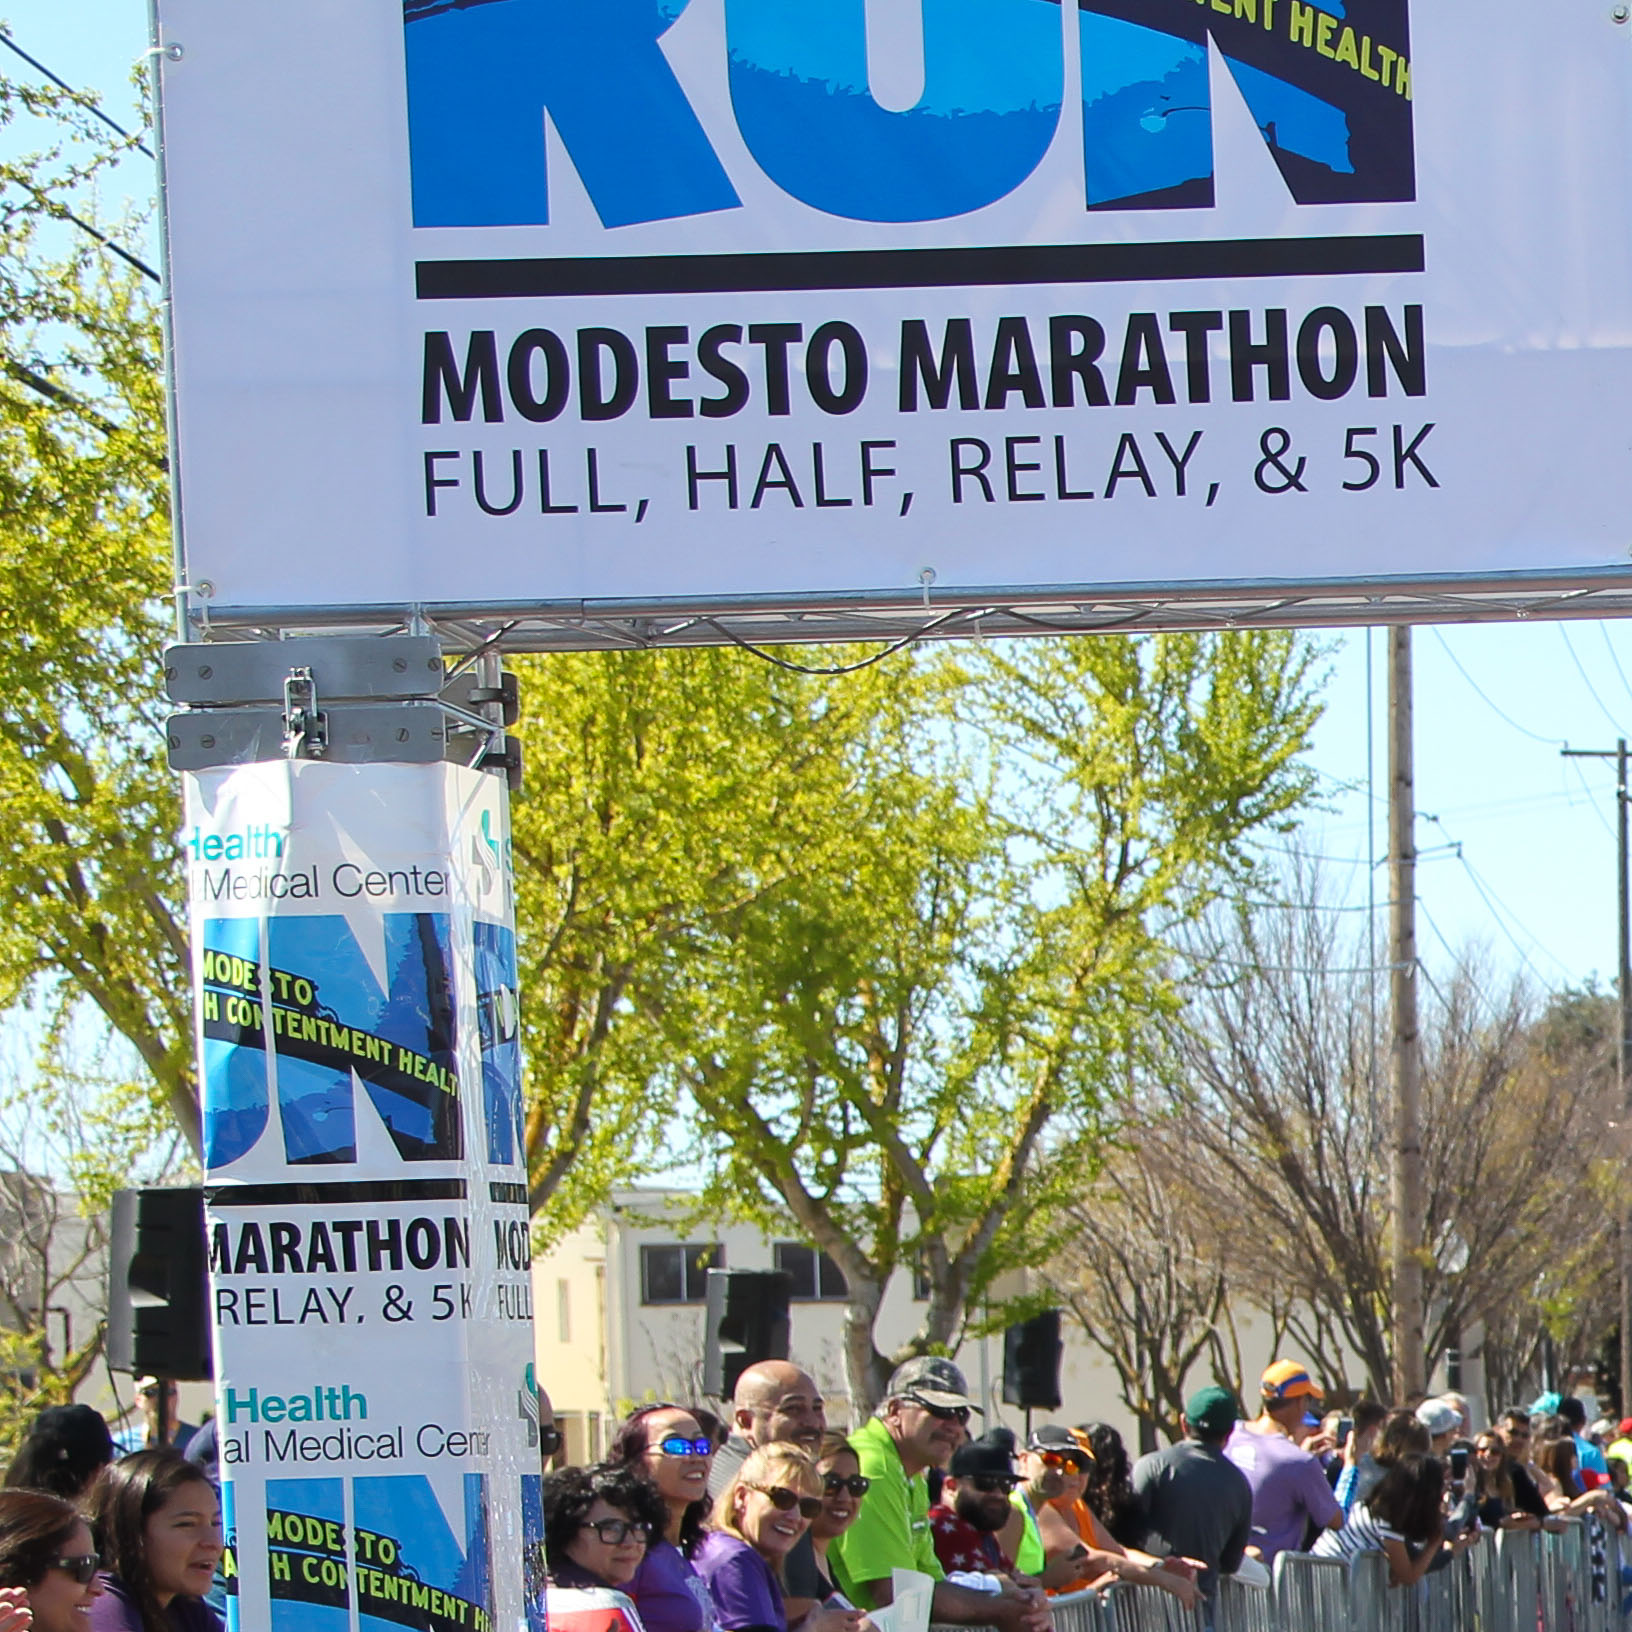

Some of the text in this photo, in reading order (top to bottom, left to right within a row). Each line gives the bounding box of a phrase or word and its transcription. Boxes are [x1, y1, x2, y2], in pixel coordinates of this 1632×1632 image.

[1289, 0, 1414, 101] HEALTH
[420, 303, 1428, 426] MODESTO MARATHON
[421, 420, 1443, 528] FULL, HALF, RELAY, & 5K
[204, 864, 319, 901] Medical
[209, 1216, 471, 1275] MARATHON
[217, 1285, 366, 1326] RELAY,
[382, 1284, 413, 1322] &
[227, 1384, 368, 1424] Health
[264, 1425, 405, 1463] Medical
